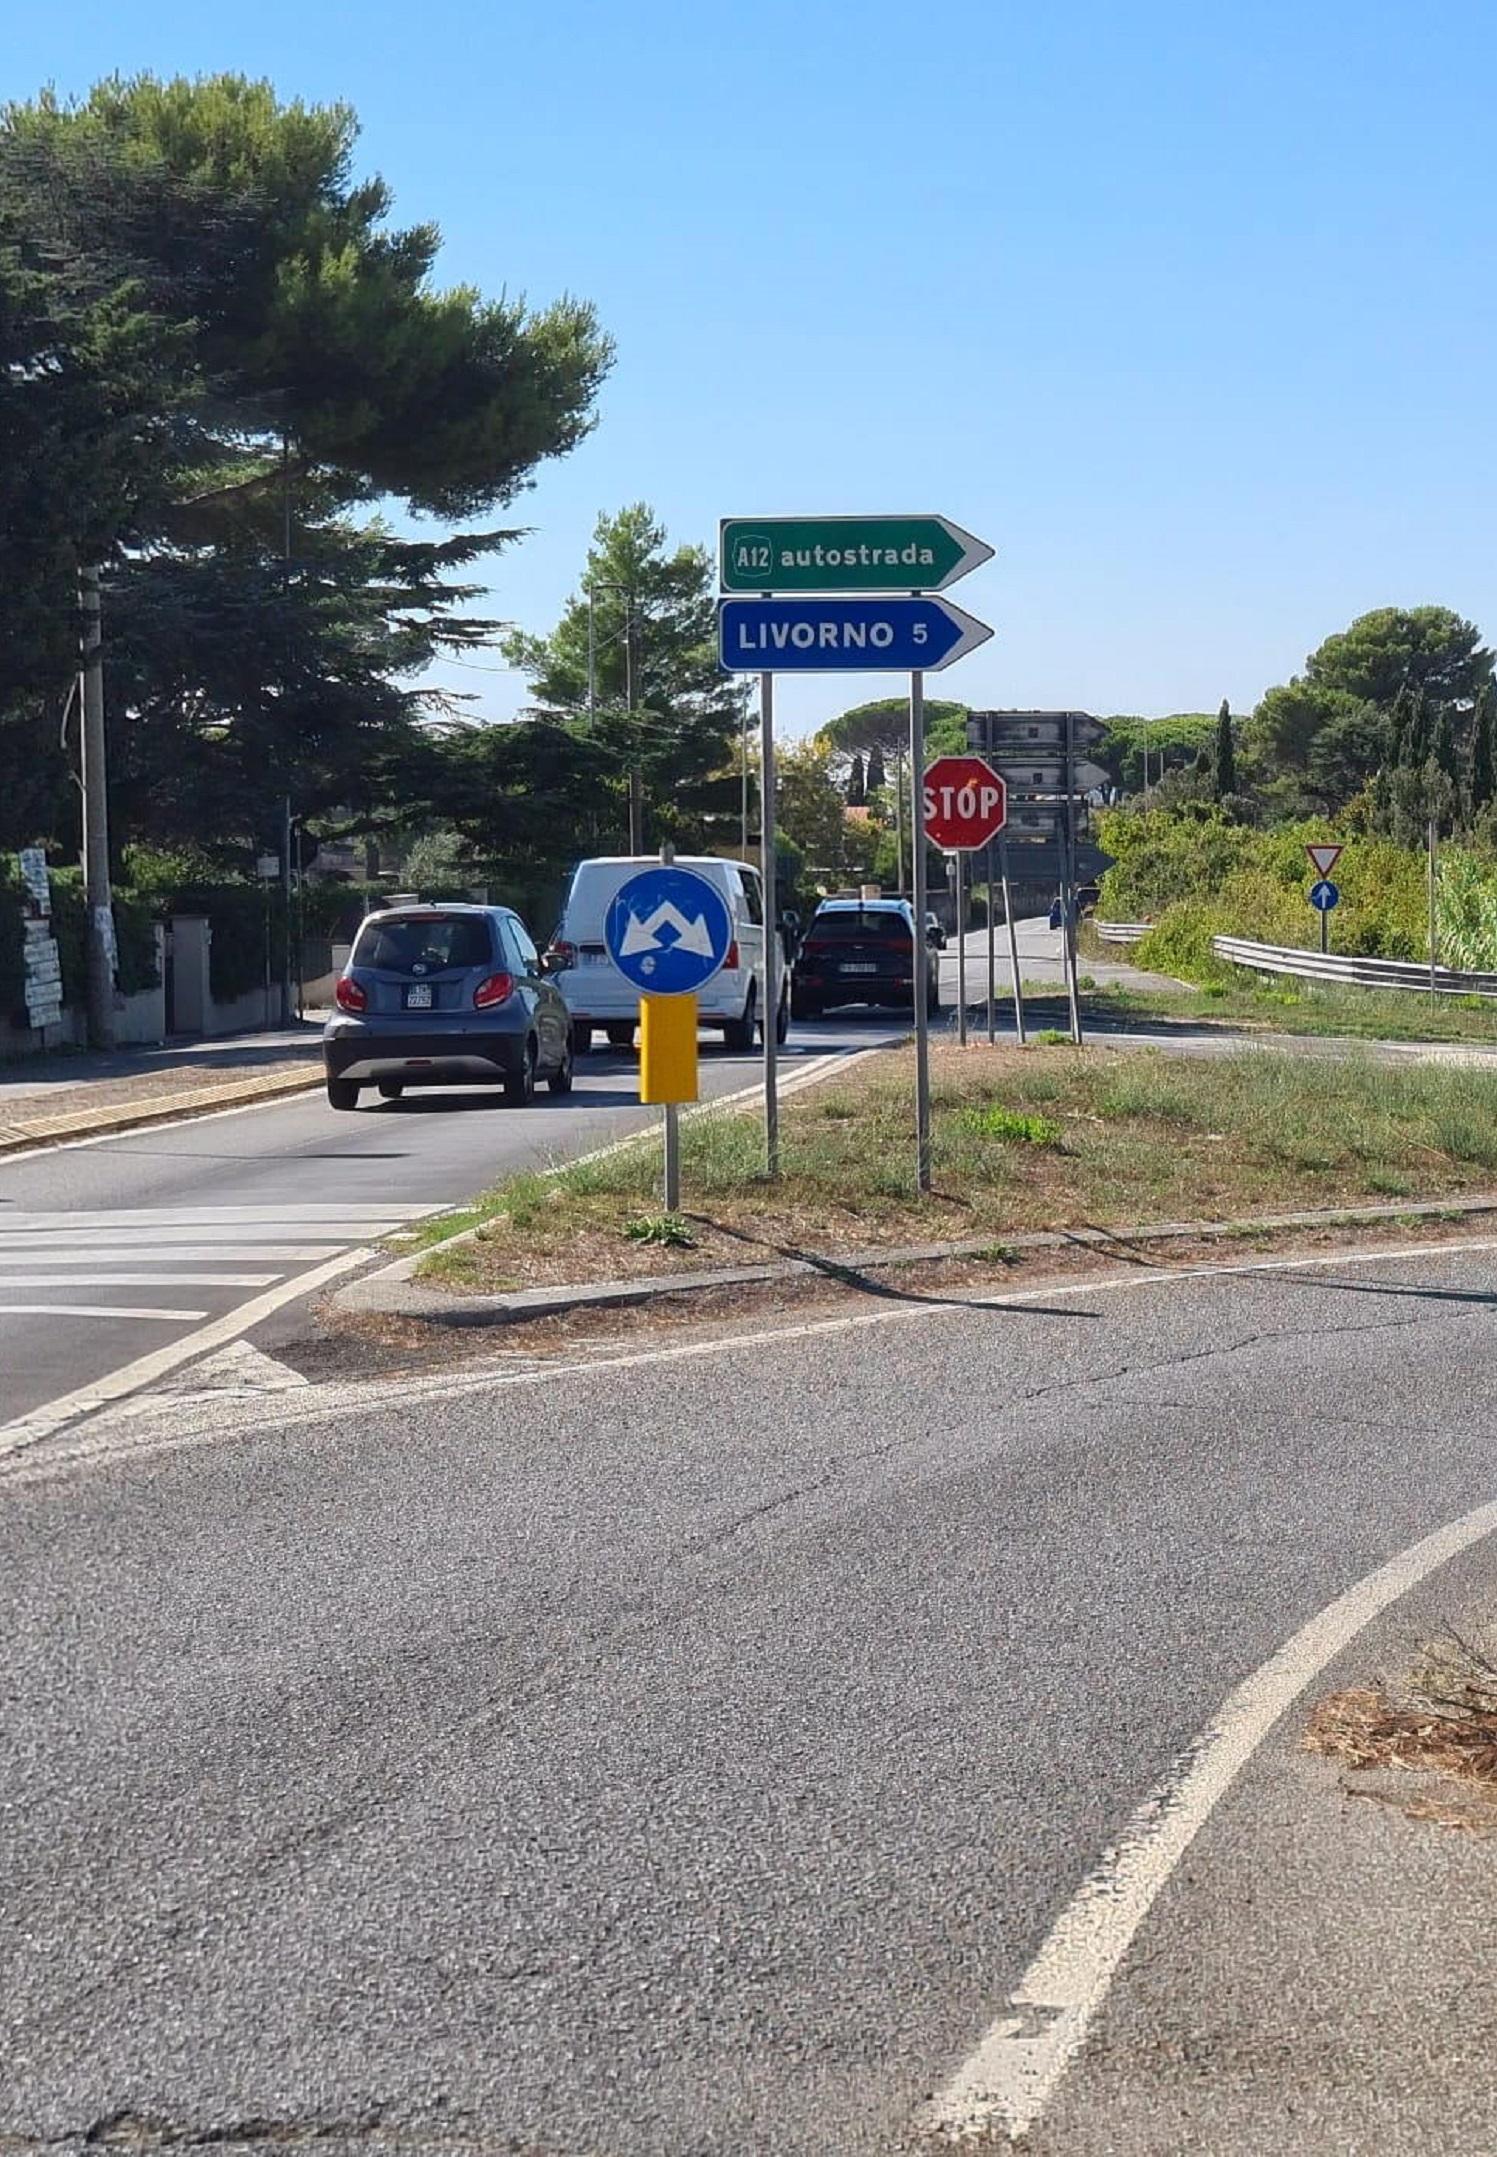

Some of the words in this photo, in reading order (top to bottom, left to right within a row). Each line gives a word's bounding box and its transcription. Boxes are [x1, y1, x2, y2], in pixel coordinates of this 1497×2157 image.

[737, 546, 769, 567] A12
[781, 543, 934, 566] autostrada
[739, 622, 894, 649] LIVORNO
[912, 623, 928, 644] 5
[923, 786, 999, 820] STOP
